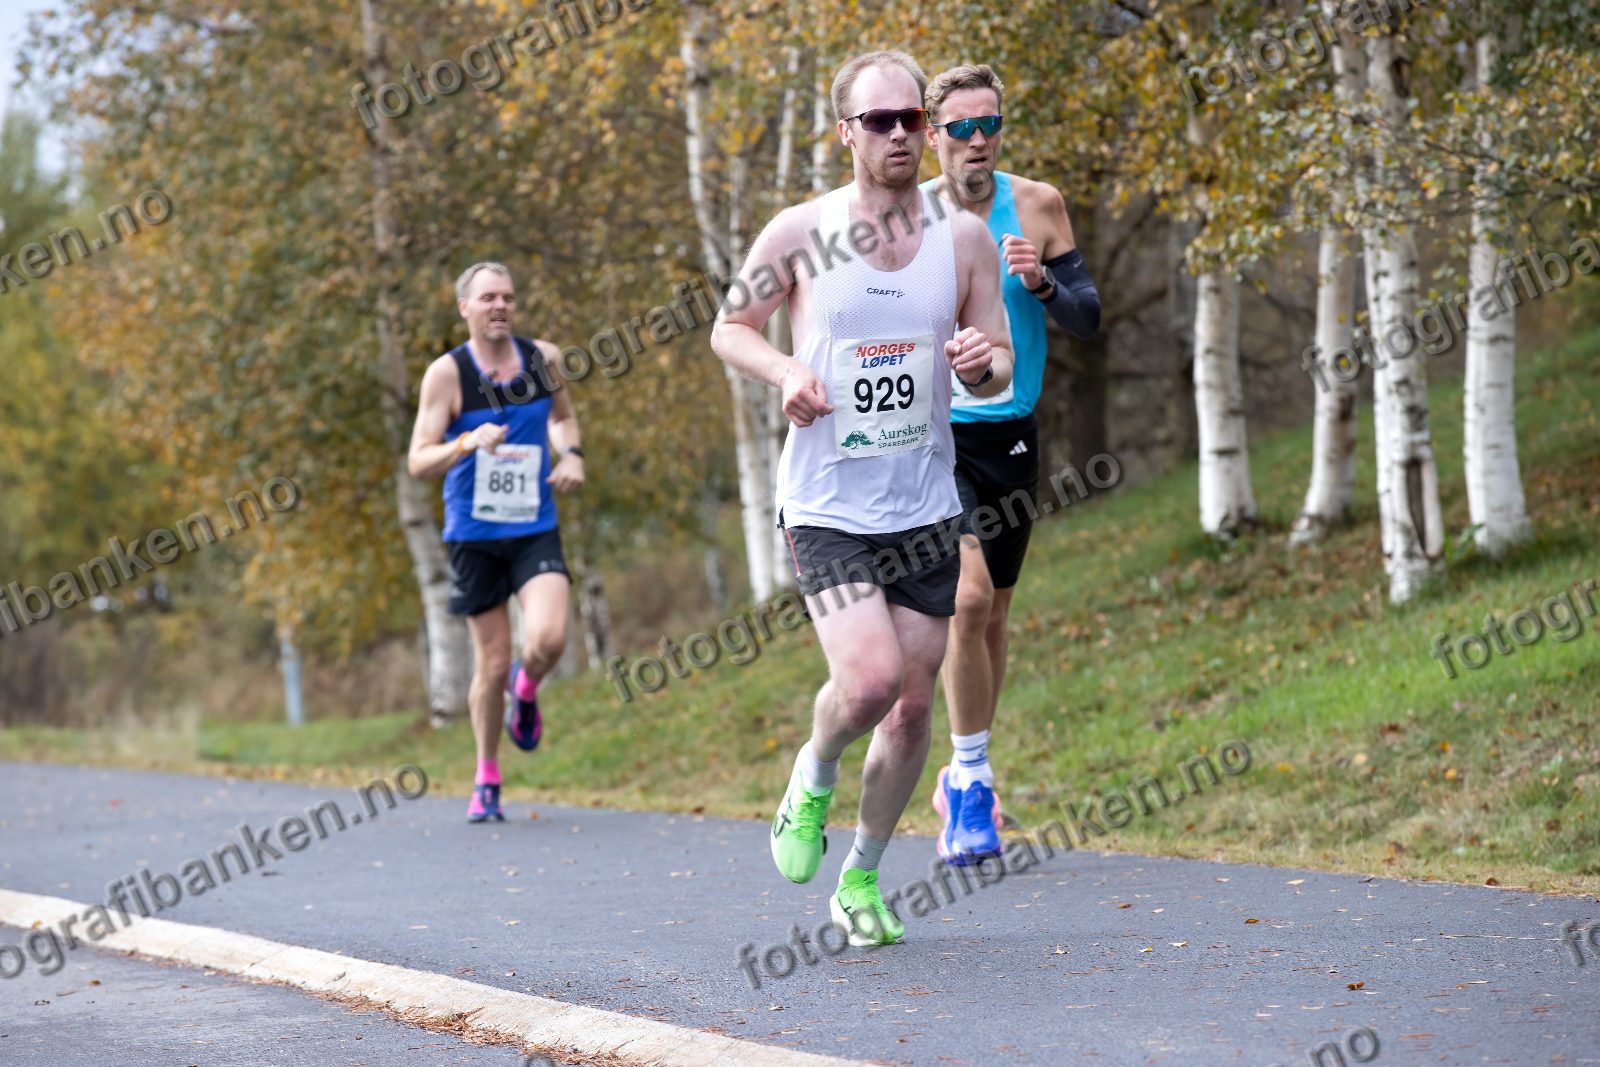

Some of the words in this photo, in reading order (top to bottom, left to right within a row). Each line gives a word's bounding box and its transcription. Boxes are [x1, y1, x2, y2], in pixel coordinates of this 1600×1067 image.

[866, 287, 897, 297] CRAFT
[857, 342, 916, 358] NORGES
[861, 353, 907, 369] LØPET
[854, 373, 915, 413] 929
[877, 423, 928, 441] Aurskog
[877, 436, 920, 449] SPAREBANK
[488, 470, 525, 494] 881
